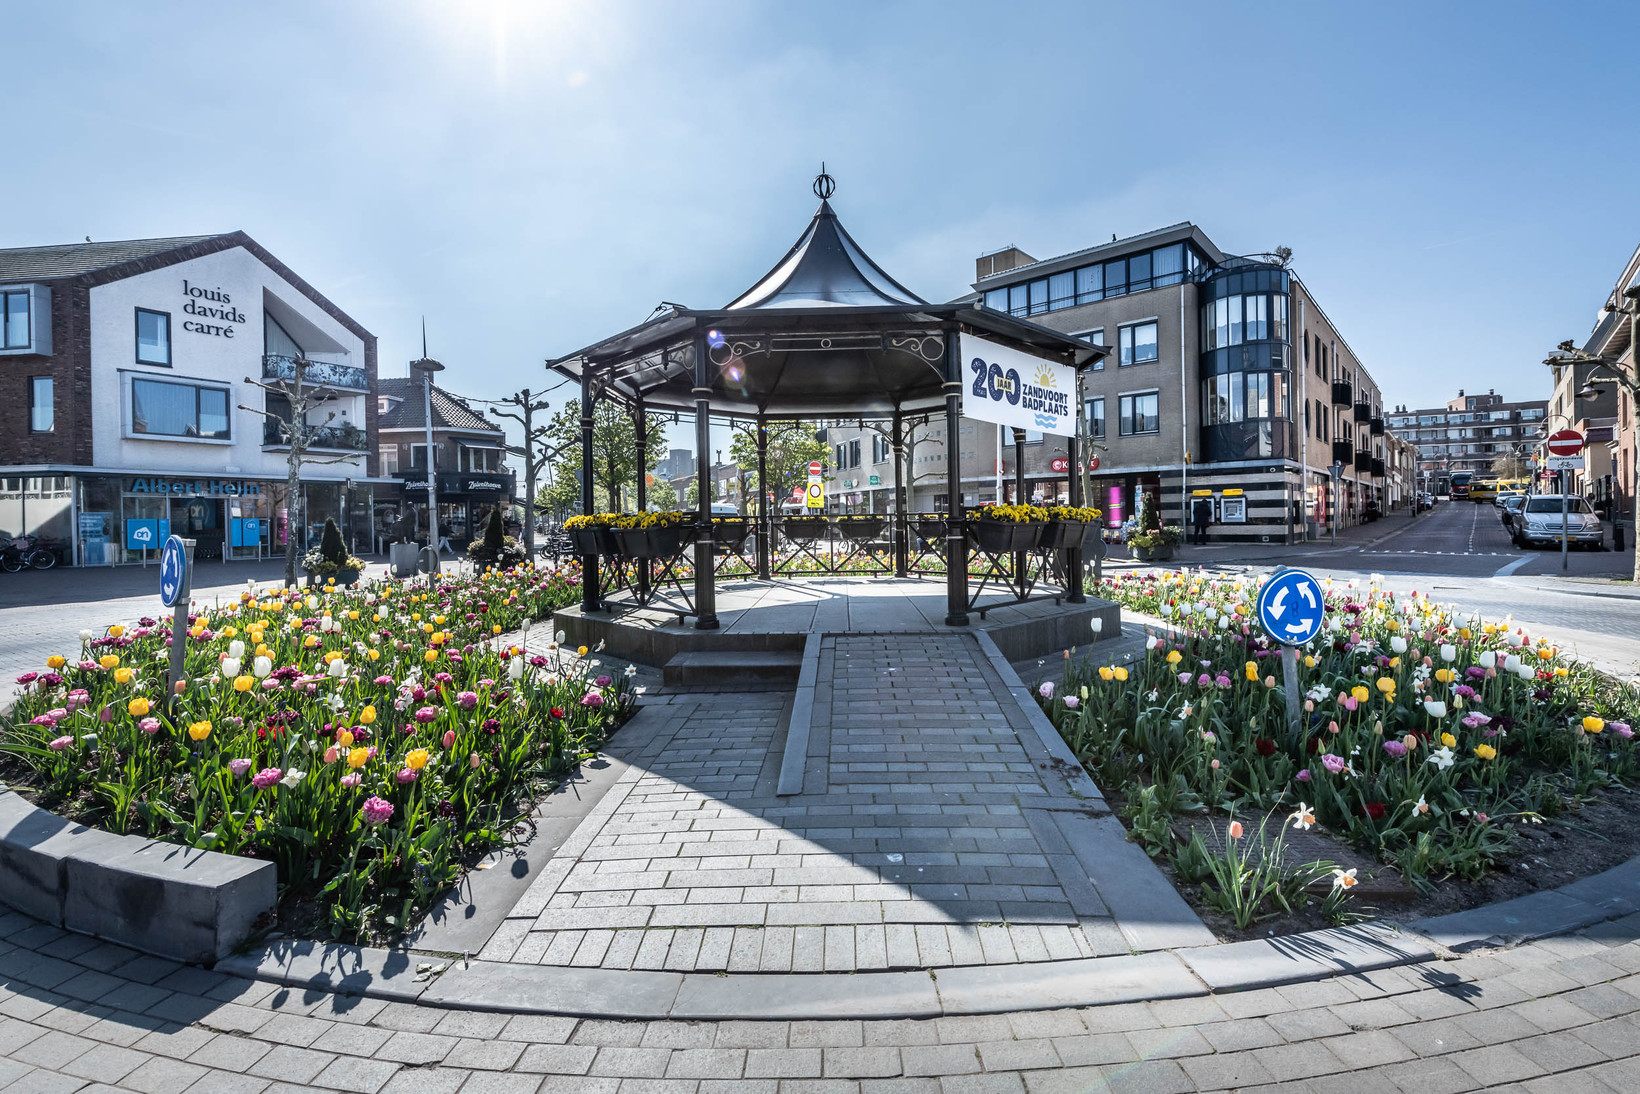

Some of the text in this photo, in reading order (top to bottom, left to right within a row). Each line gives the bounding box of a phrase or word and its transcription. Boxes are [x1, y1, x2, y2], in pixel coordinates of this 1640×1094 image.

[183, 279, 231, 304] louis
[183, 299, 246, 324] davids
[183, 320, 234, 339] carré
[971, 357, 1021, 406] 200
[997, 377, 1012, 390] JAAR
[1022, 383, 1068, 404] ZANDVOORT
[1022, 395, 1069, 416] BADPLAATS
[132, 478, 260, 497] Albert Heijn
